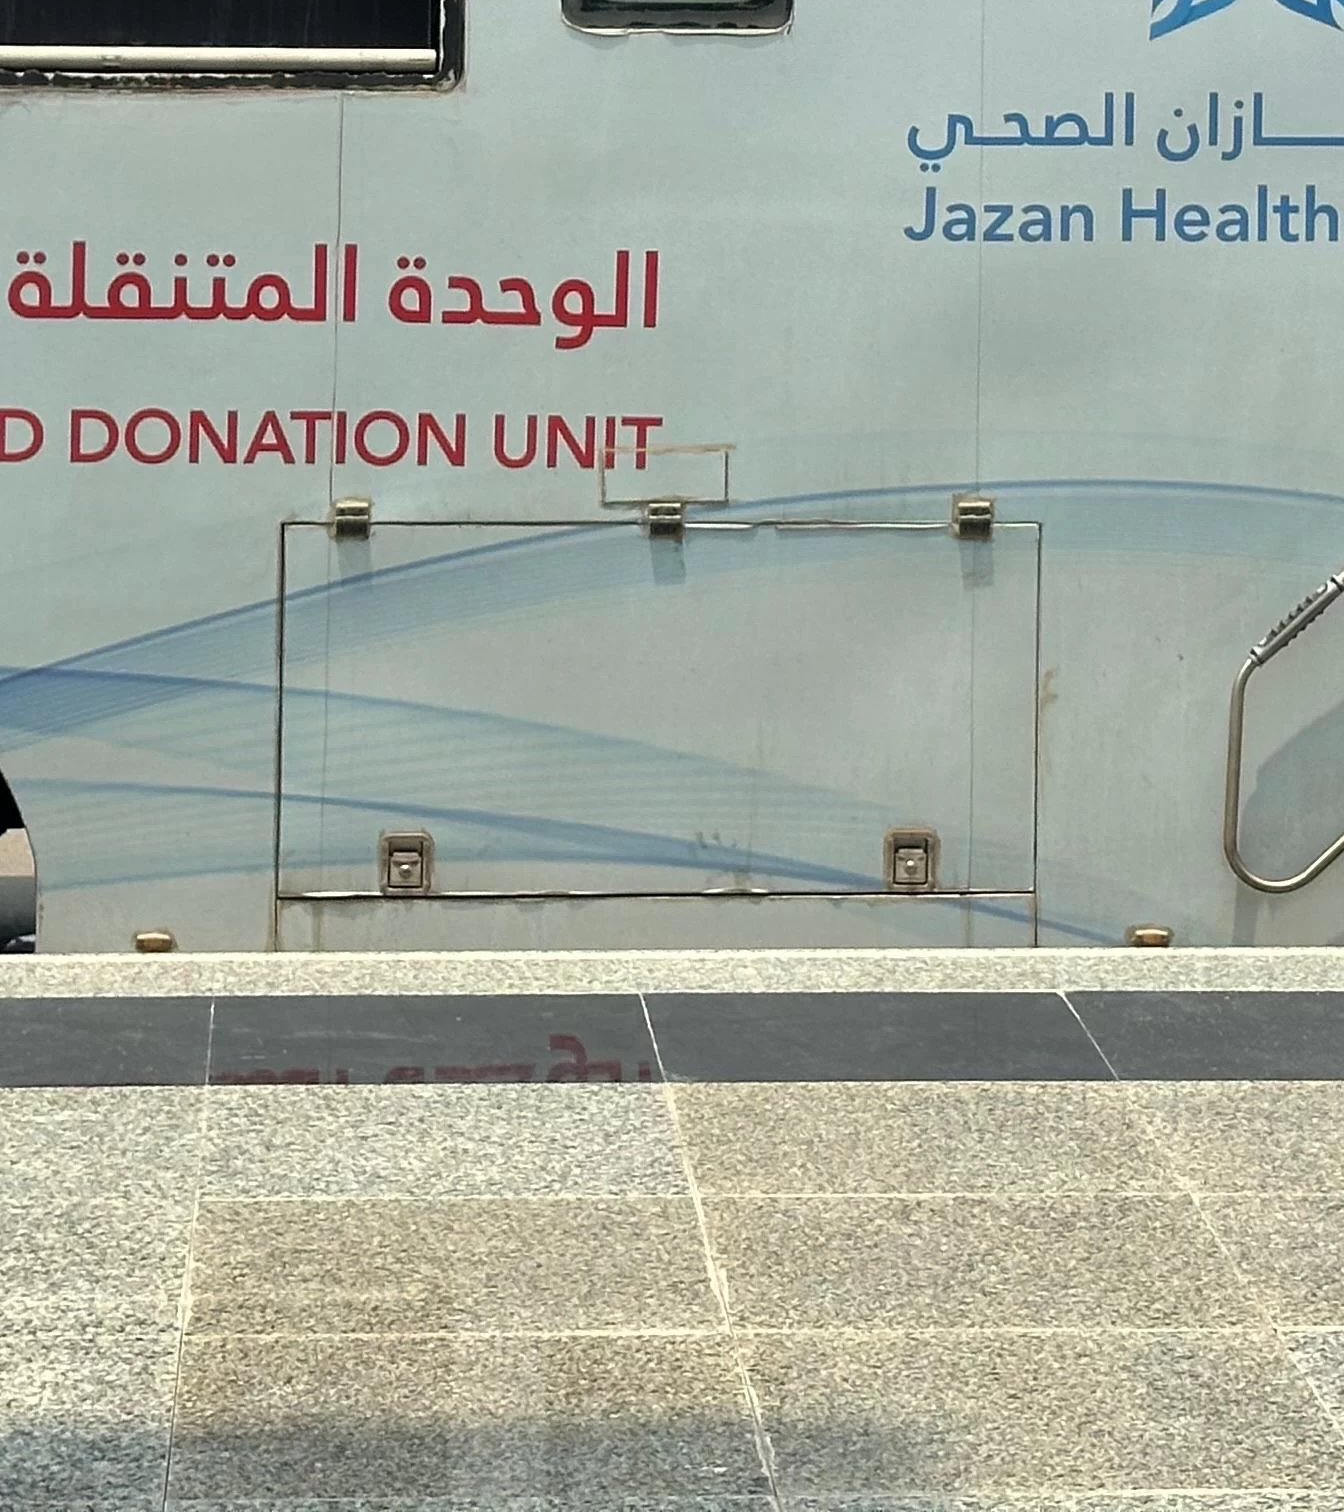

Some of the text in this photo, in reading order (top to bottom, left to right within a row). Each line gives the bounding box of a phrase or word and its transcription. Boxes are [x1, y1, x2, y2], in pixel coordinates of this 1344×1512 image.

[906, 91, 1136, 174] الصحي
[903, 186, 1096, 244] Jazan
[1119, 183, 1340, 244] Health
[7, 240, 359, 324] المتنقلة
[387, 249, 659, 350] الوحدة
[69, 408, 467, 467] DONATION
[493, 414, 664, 471] UNIT
